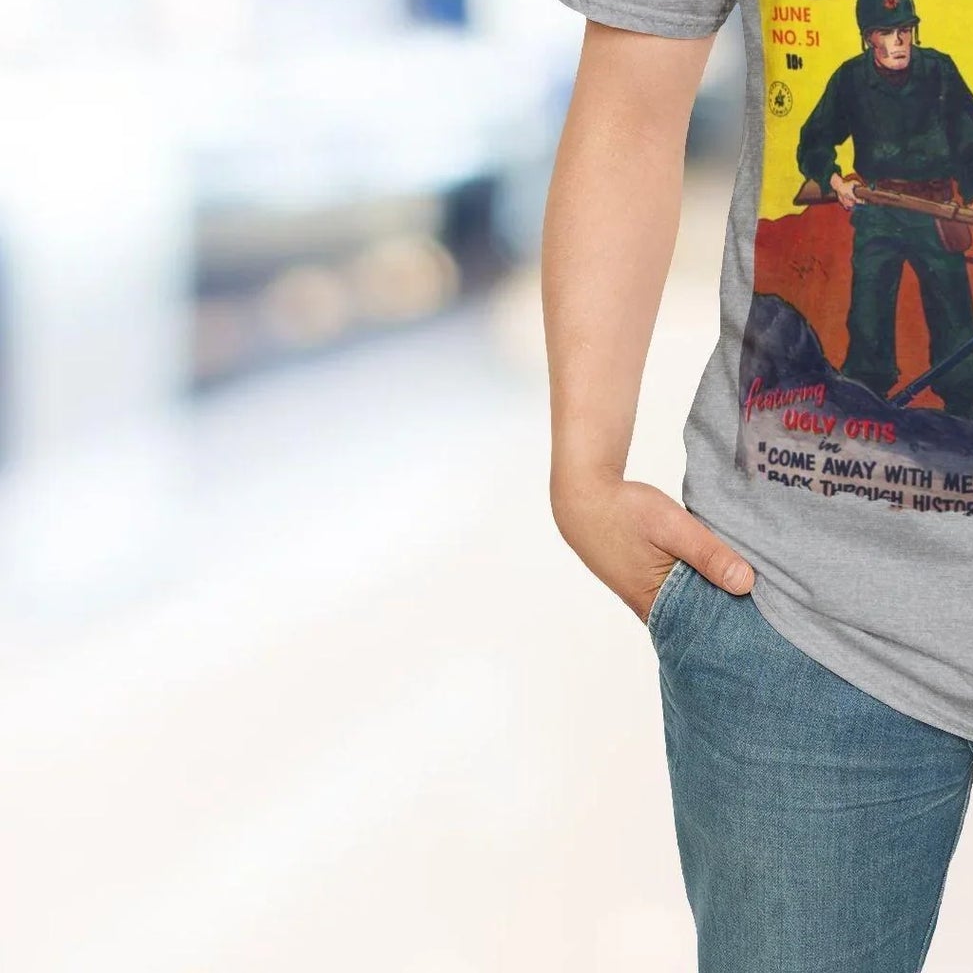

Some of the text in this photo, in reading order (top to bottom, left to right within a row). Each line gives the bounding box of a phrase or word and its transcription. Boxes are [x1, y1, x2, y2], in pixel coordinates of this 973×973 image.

[772, 6, 811, 23] JUNE
[744, 377, 826, 422] featuring
[782, 409, 897, 444] UGLY OTIS
[818, 437, 842, 454] in
[822, 457, 876, 480] AWAY
[884, 465, 932, 489] WITH
